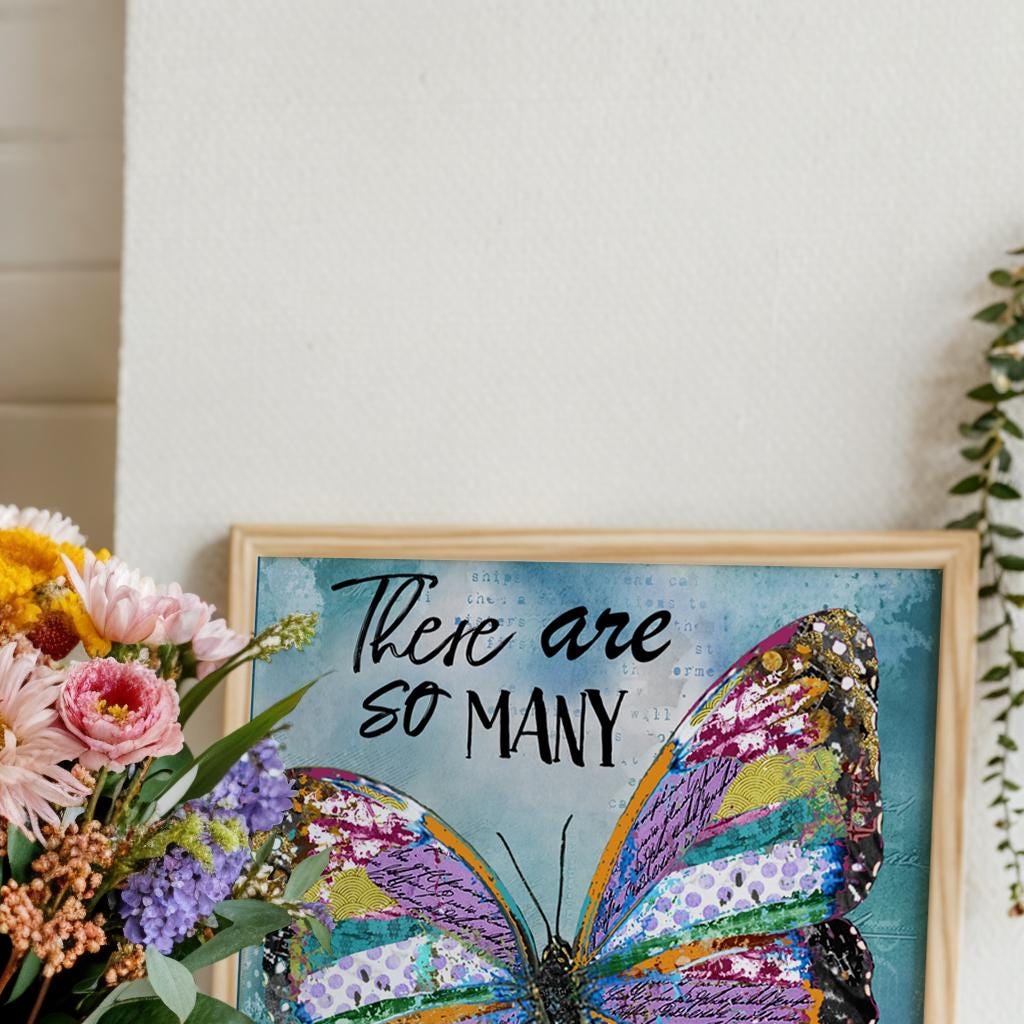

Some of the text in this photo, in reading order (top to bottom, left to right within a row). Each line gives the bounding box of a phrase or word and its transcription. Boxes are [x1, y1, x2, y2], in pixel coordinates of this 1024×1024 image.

[332, 574, 671, 674] There are
[465, 687, 628, 767] MANY
